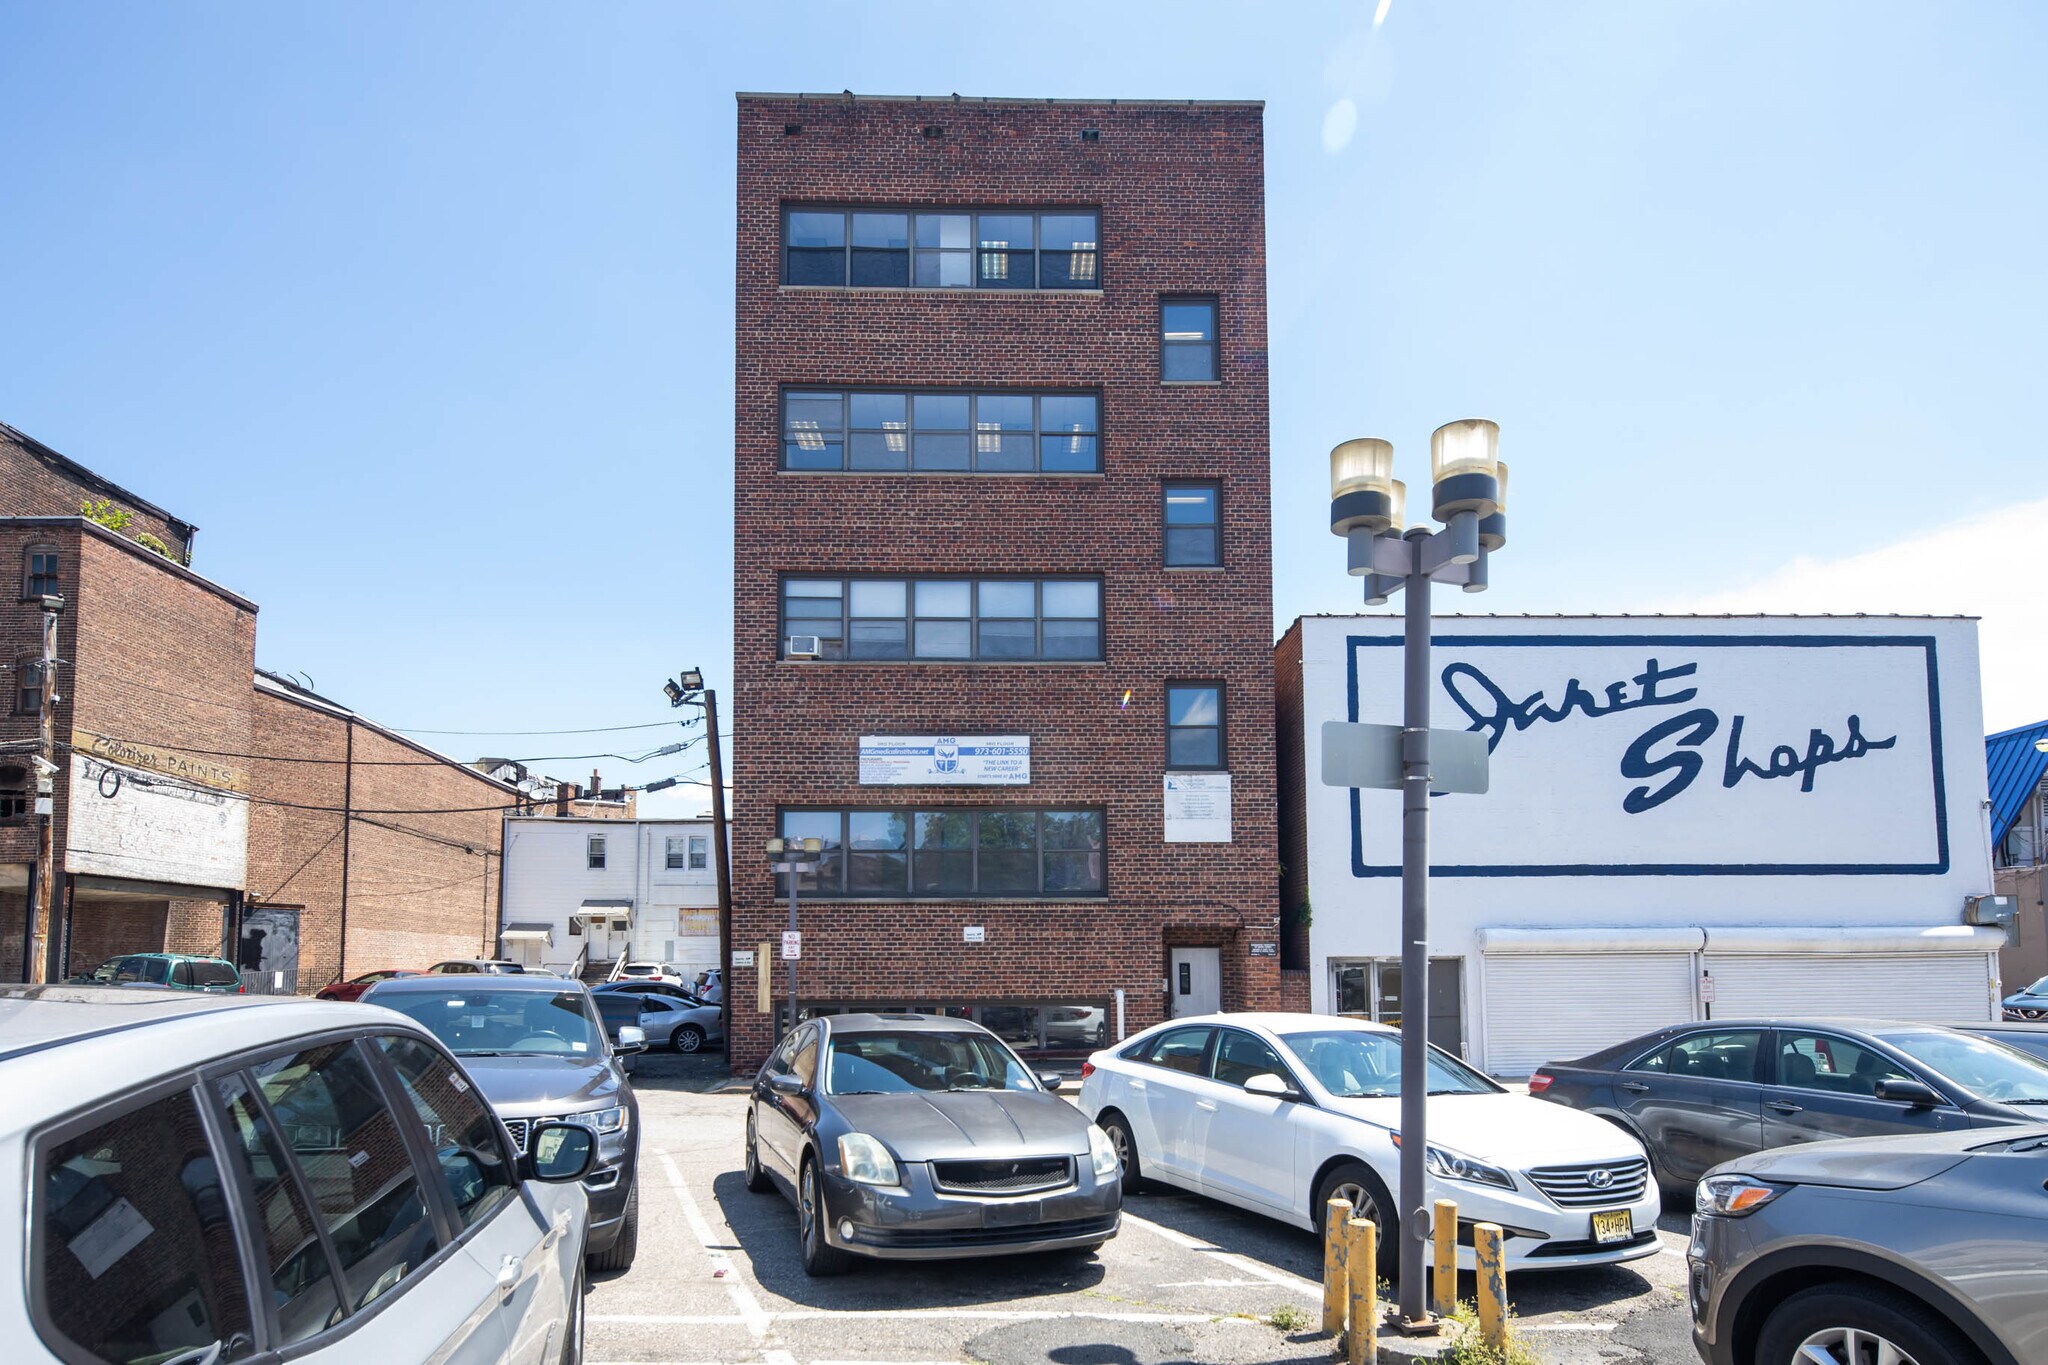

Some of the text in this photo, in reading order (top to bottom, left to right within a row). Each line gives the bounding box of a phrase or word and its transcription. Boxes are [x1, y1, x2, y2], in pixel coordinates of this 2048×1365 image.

[1440, 658, 1698, 757] Jaret
[167, 756, 232, 783] PAINTS
[974, 747, 1029, 755] 973-601-5550
[1620, 708, 1897, 815] Shops
